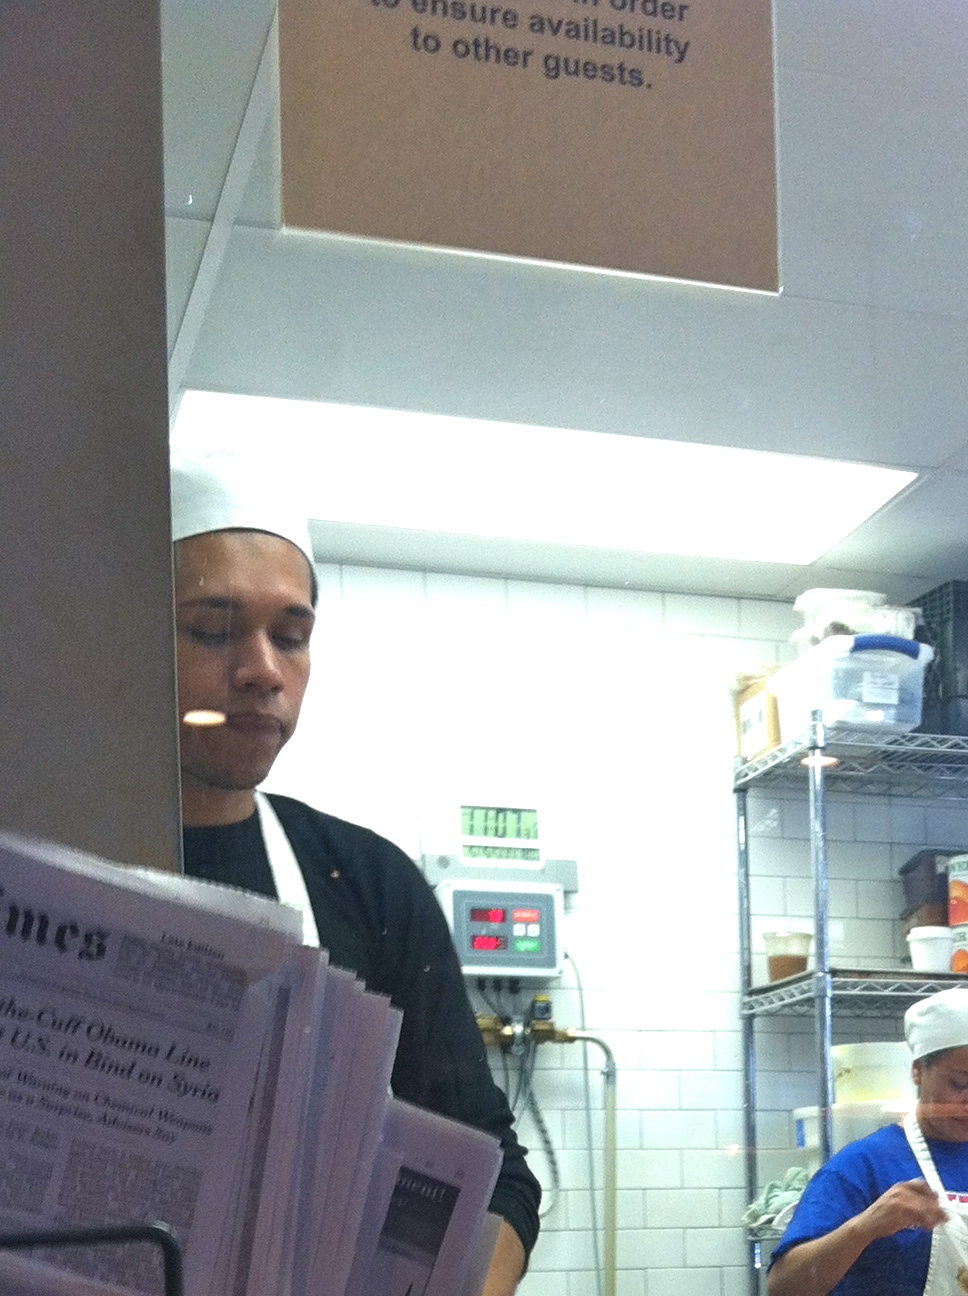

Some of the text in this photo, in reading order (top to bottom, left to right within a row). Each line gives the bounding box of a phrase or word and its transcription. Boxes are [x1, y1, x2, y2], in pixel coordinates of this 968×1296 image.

[410, 0, 519, 29] ensure
[528, 13, 691, 64] availability
[410, 24, 653, 89] to other guests.
[4, 902, 111, 962] mes
[58, 1045, 80, 1064] in
[84, 1049, 137, 1079] Bind
[137, 1068, 164, 1088] on
[168, 1072, 221, 1104] Syria
[86, 1021, 160, 1057] Obama
[165, 1042, 212, 1070] Line
